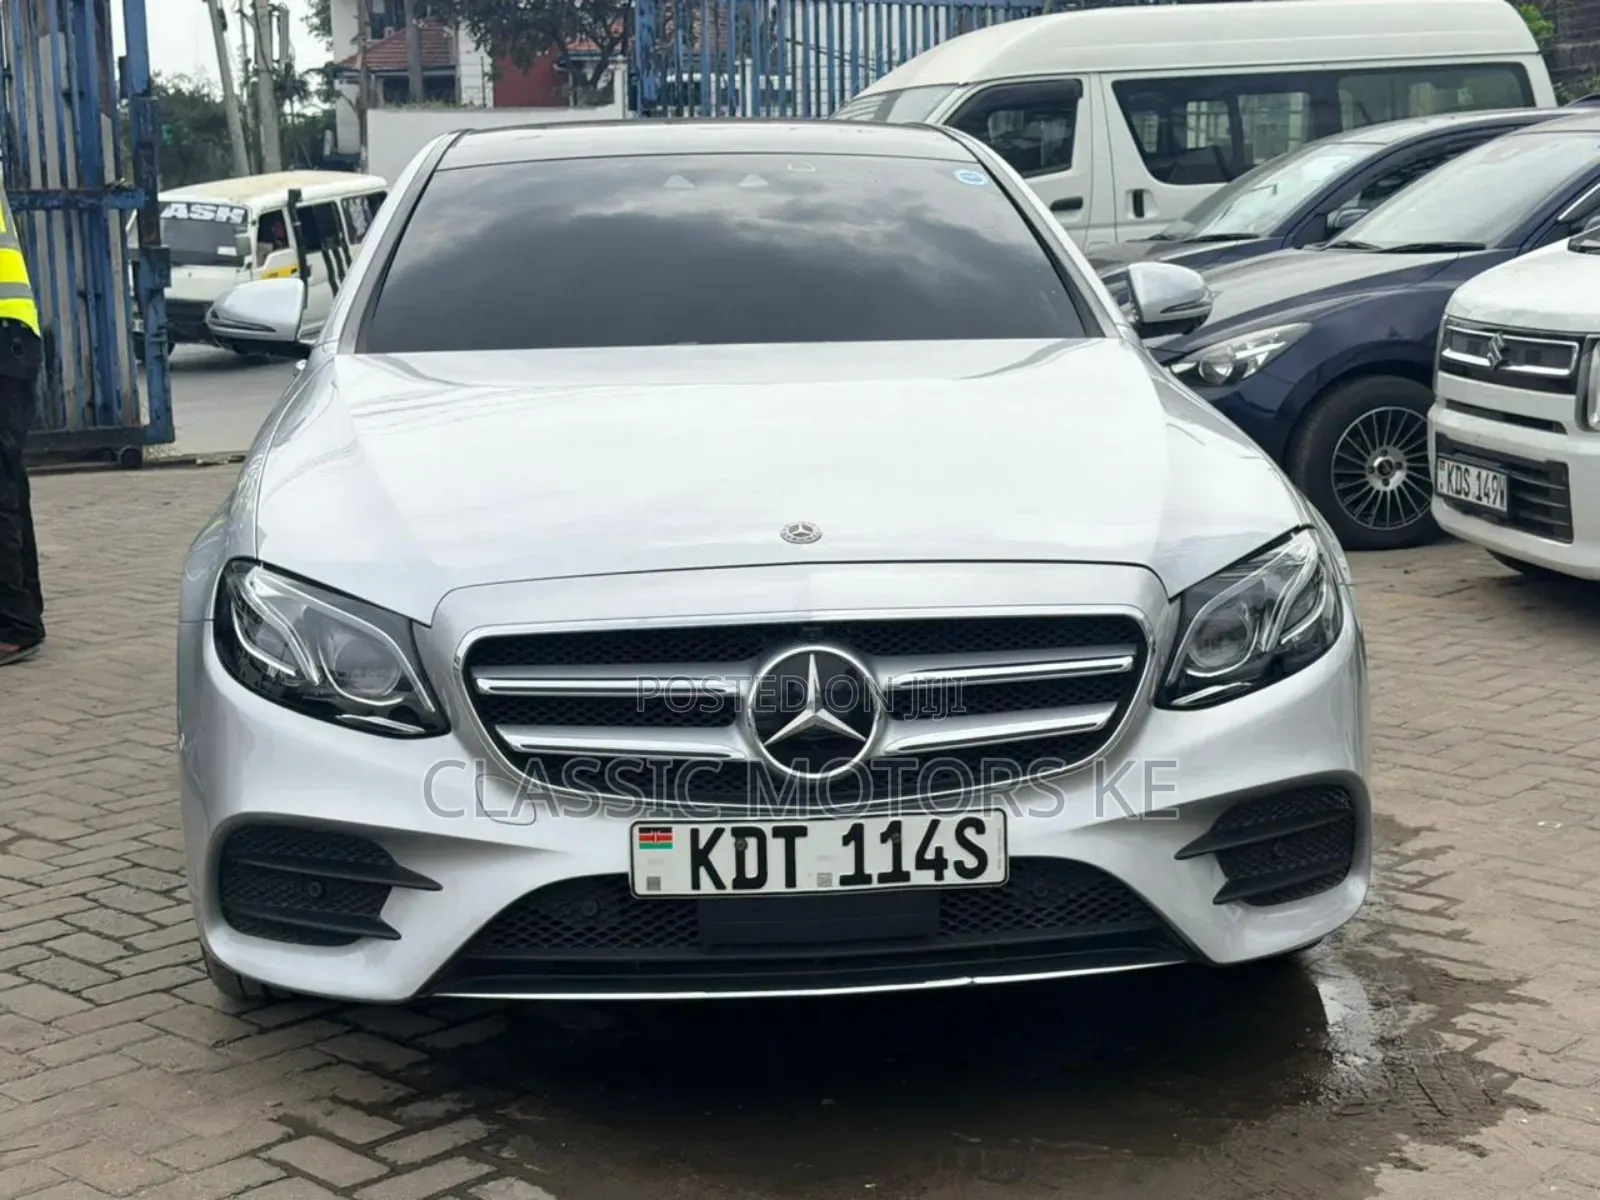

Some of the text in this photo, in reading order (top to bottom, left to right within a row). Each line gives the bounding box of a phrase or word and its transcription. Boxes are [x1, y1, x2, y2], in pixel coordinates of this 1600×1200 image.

[1447, 463, 1470, 498] KDS
[690, 826, 808, 891] KDT
[838, 816, 989, 887] 114S
